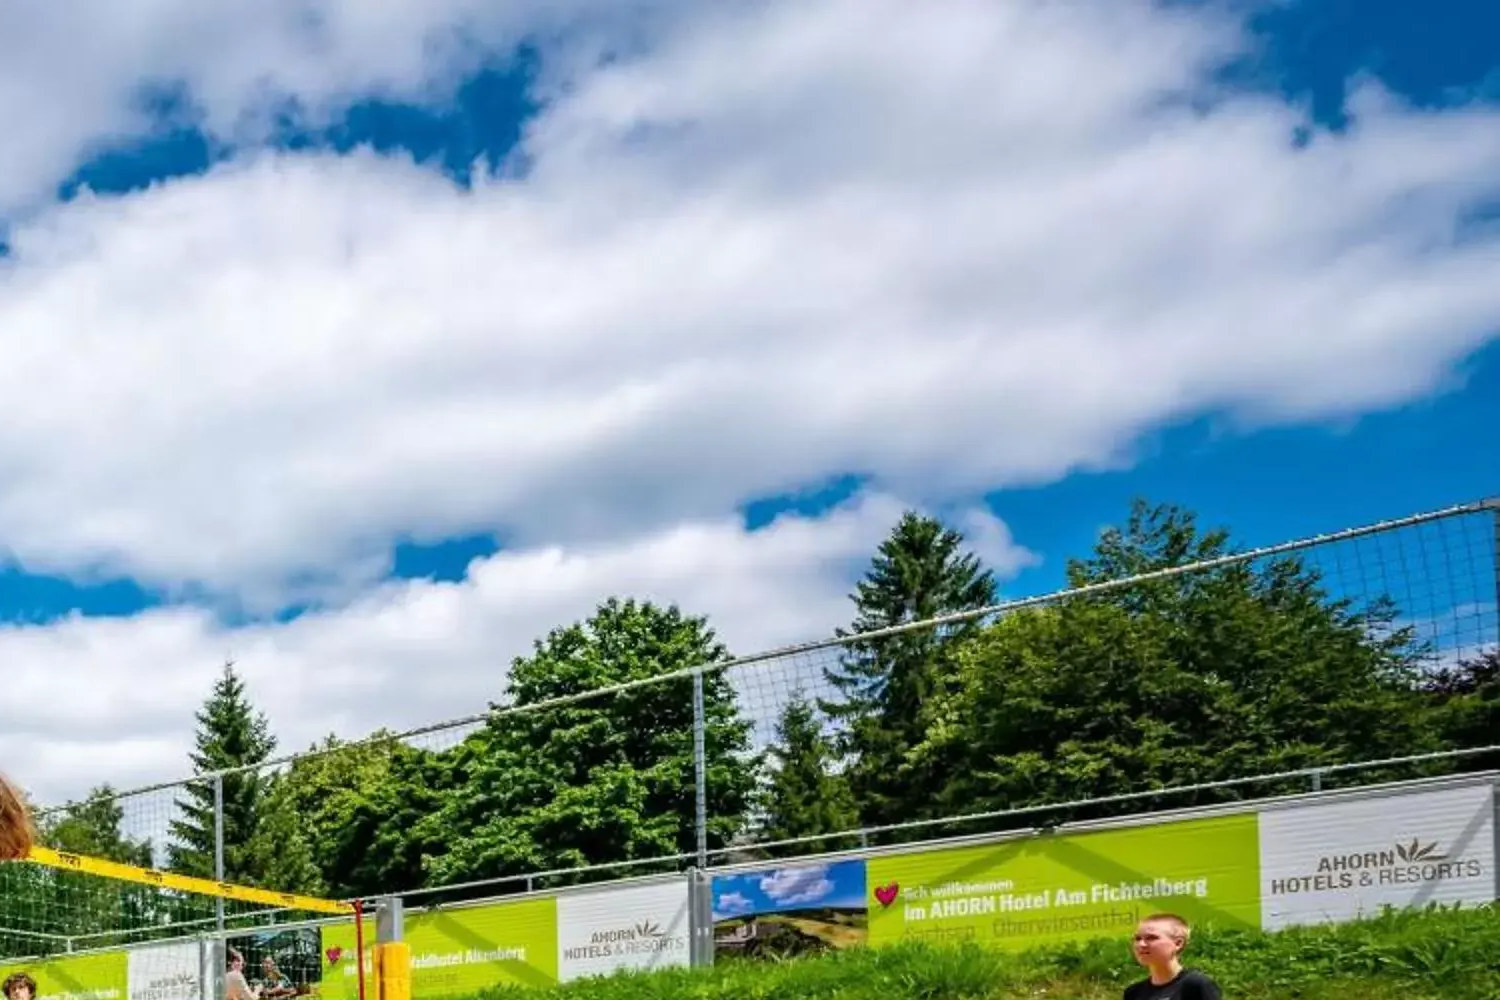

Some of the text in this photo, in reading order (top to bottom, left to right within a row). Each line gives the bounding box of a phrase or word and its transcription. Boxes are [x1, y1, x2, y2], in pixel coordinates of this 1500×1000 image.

[1317, 849, 1395, 873] AHORN
[930, 879, 1014, 898] willkommen
[1271, 859, 1481, 895] HOTELS & RESORTS
[903, 878, 1208, 921] im AHORN Hotel Am Fichtelberg
[563, 945, 613, 960] HOTELS
